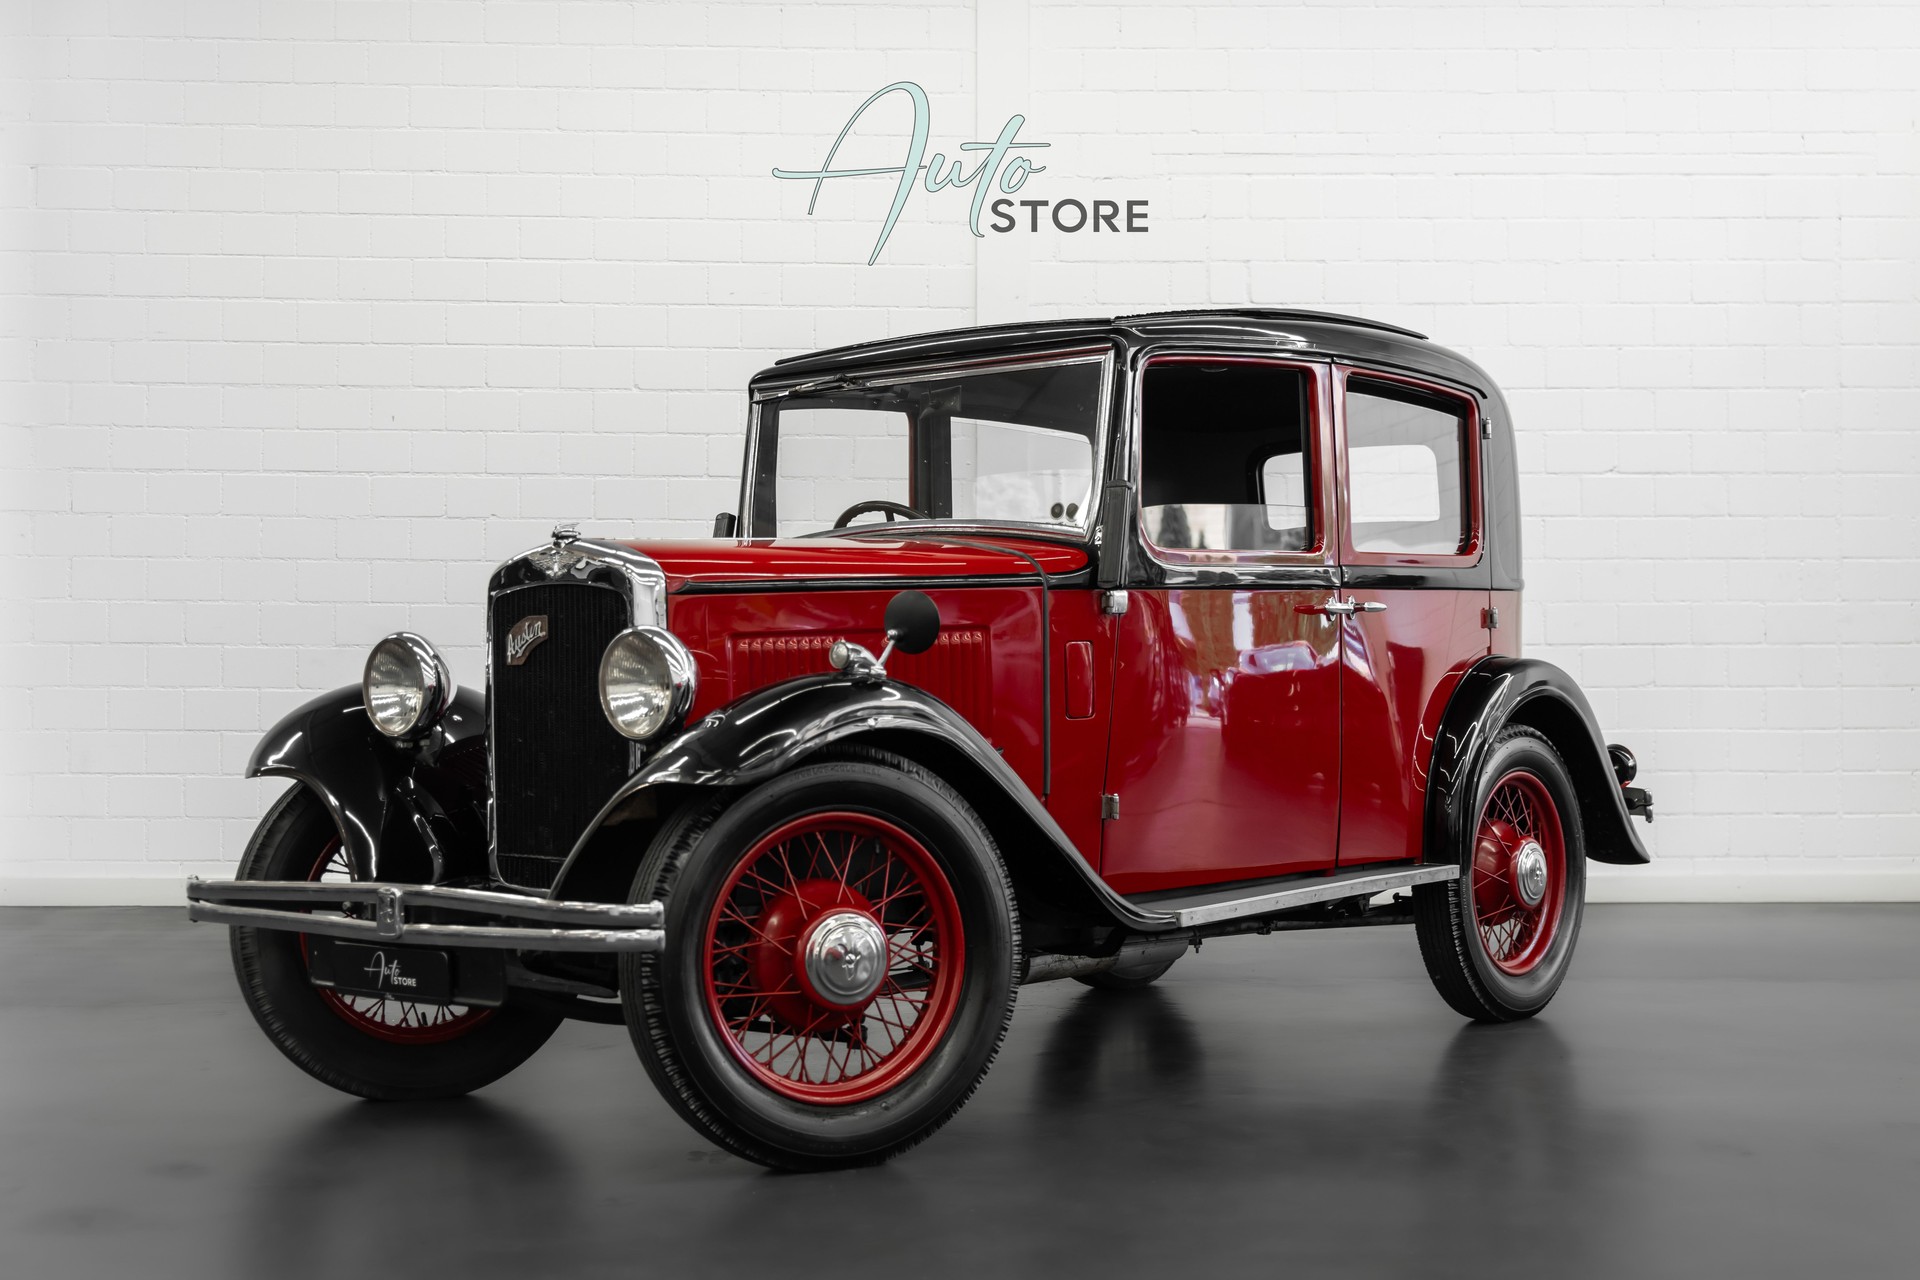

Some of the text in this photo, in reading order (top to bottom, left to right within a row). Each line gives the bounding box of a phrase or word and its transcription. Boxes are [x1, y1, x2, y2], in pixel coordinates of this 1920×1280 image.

[772, 81, 1051, 266] Auto
[990, 198, 1149, 233] STORE
[507, 621, 546, 662] Austin
[364, 951, 401, 989] Auto
[393, 976, 417, 987] STORE
